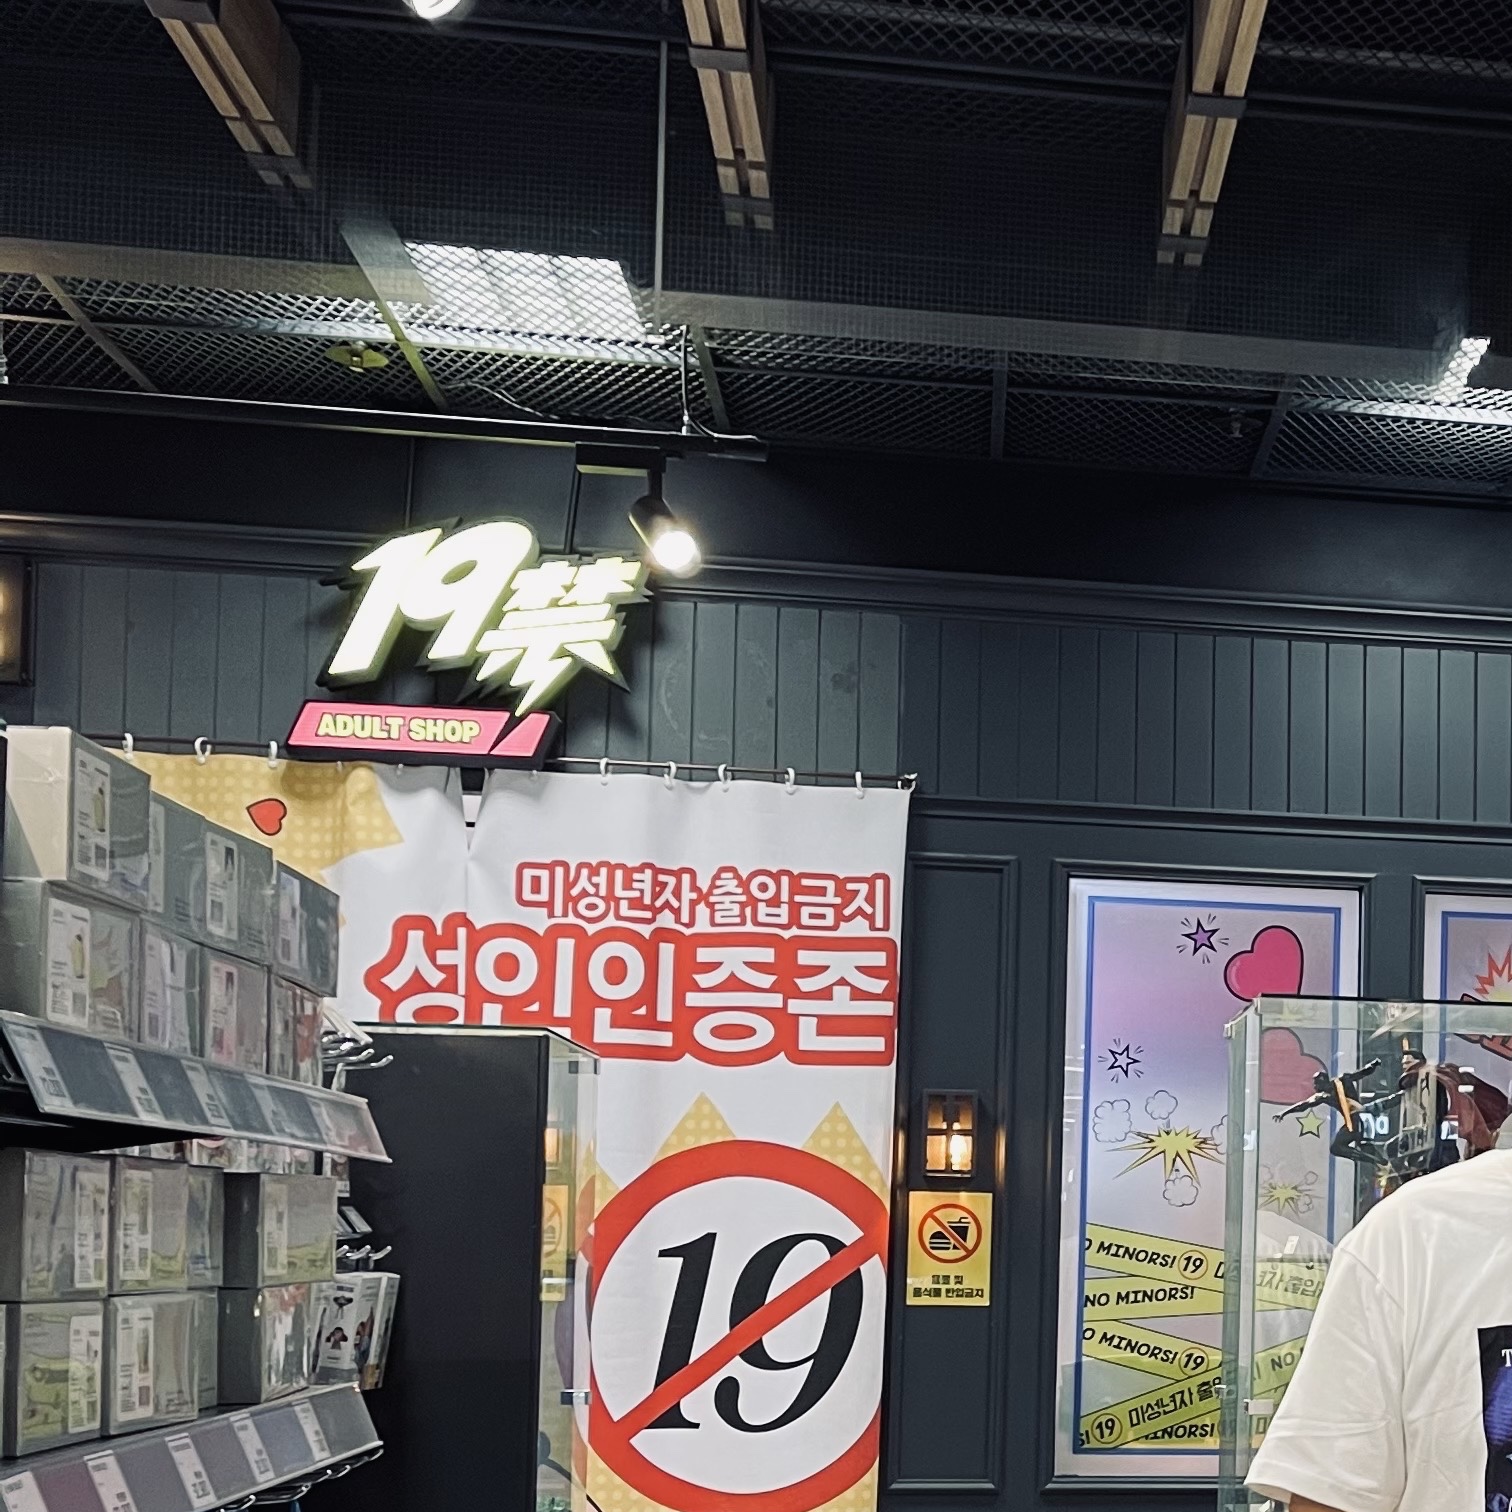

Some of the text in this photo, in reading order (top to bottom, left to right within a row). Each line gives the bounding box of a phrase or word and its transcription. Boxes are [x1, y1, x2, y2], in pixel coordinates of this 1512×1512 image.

[316, 713, 482, 745] ADULT SHOP
[521, 864, 888, 929] 미성년자 출입금지
[382, 924, 894, 1053] 성인인증존
[1096, 1241, 1176, 1269] MINORS!
[1182, 1255, 1204, 1274] 19
[1083, 1285, 1195, 1308] NO MINORS!
[643, 1231, 865, 1434] 19
[1098, 1328, 1178, 1365] MINORS!
[1182, 1354, 1205, 1373] 19
[1128, 1386, 1194, 1428] 미성년자
[1094, 1417, 1117, 1440] 19
